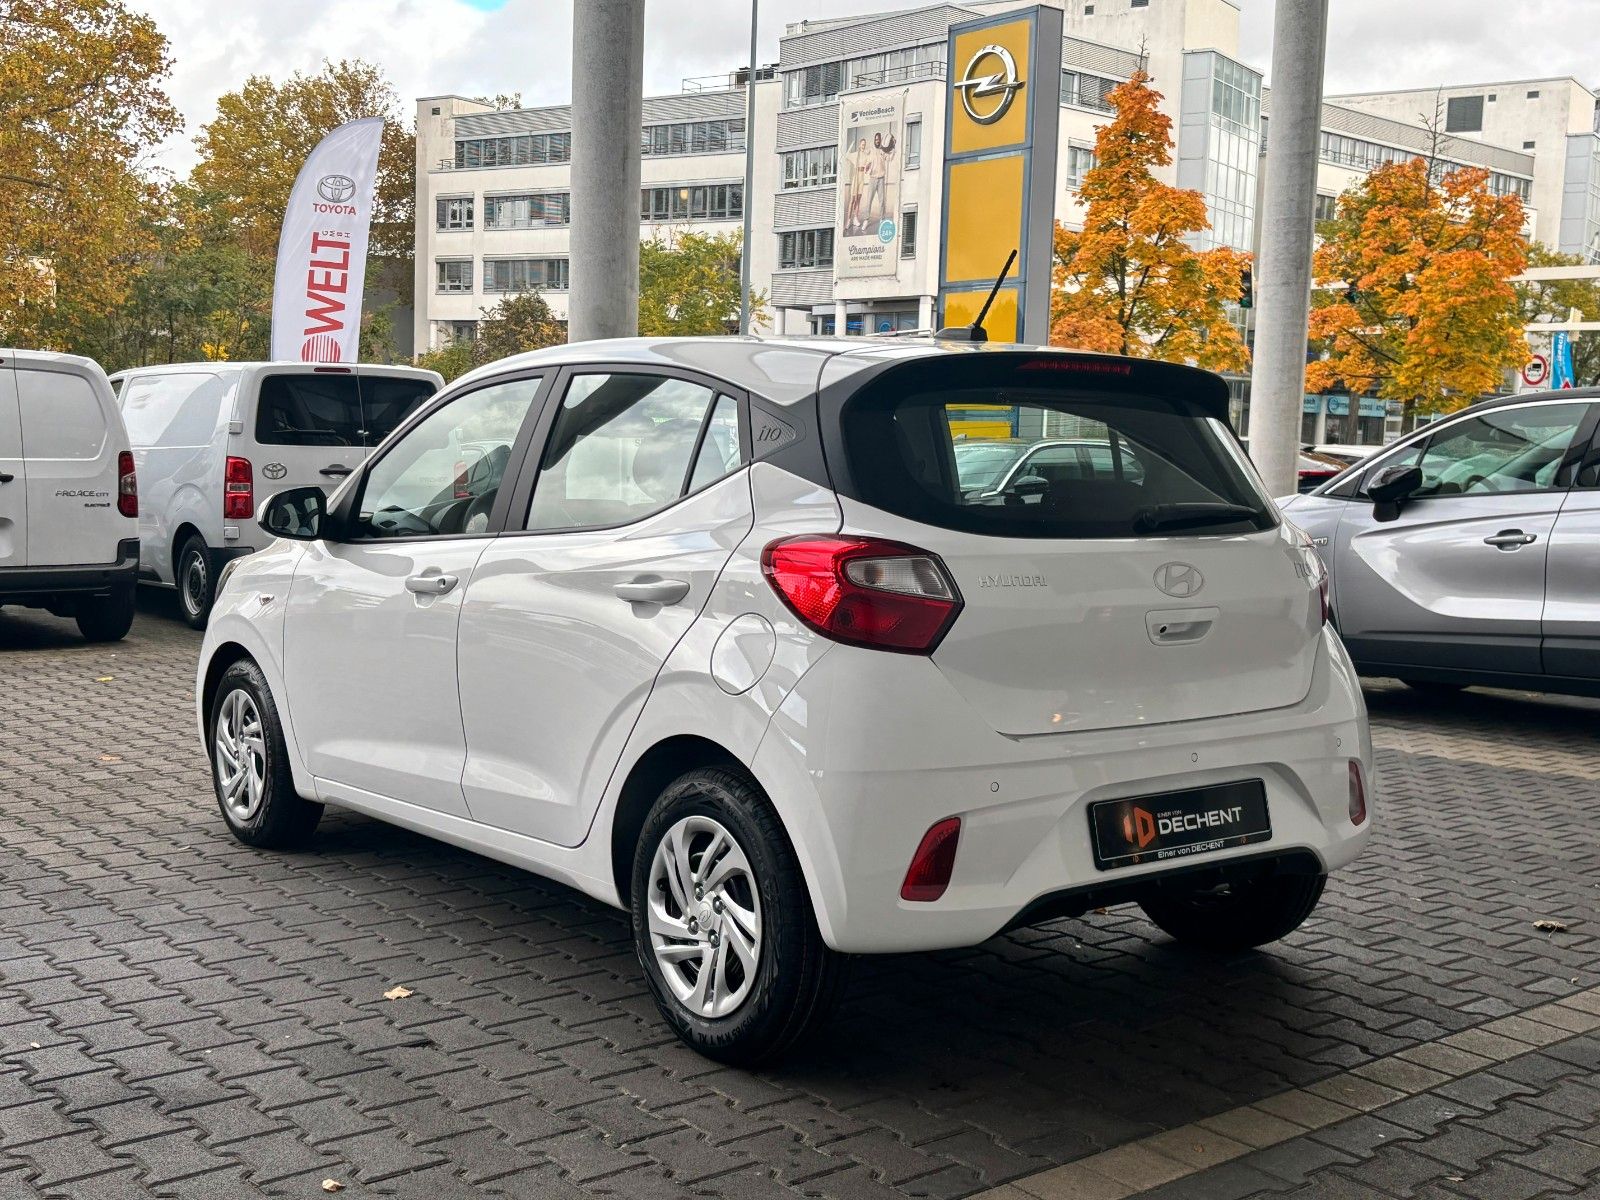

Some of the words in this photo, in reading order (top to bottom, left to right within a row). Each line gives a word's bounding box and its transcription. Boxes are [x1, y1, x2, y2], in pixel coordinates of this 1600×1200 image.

[859, 106, 895, 117] VeniceBeach
[312, 203, 357, 215] TOYOTA
[848, 245, 886, 255] Champions
[303, 231, 351, 336] WELT
[757, 425, 782, 442] i10
[977, 575, 1048, 588] HYUNDAI
[1158, 806, 1242, 835] DECHENT
[1157, 850, 1176, 859] Einer
[1191, 840, 1225, 853] DECHENT
